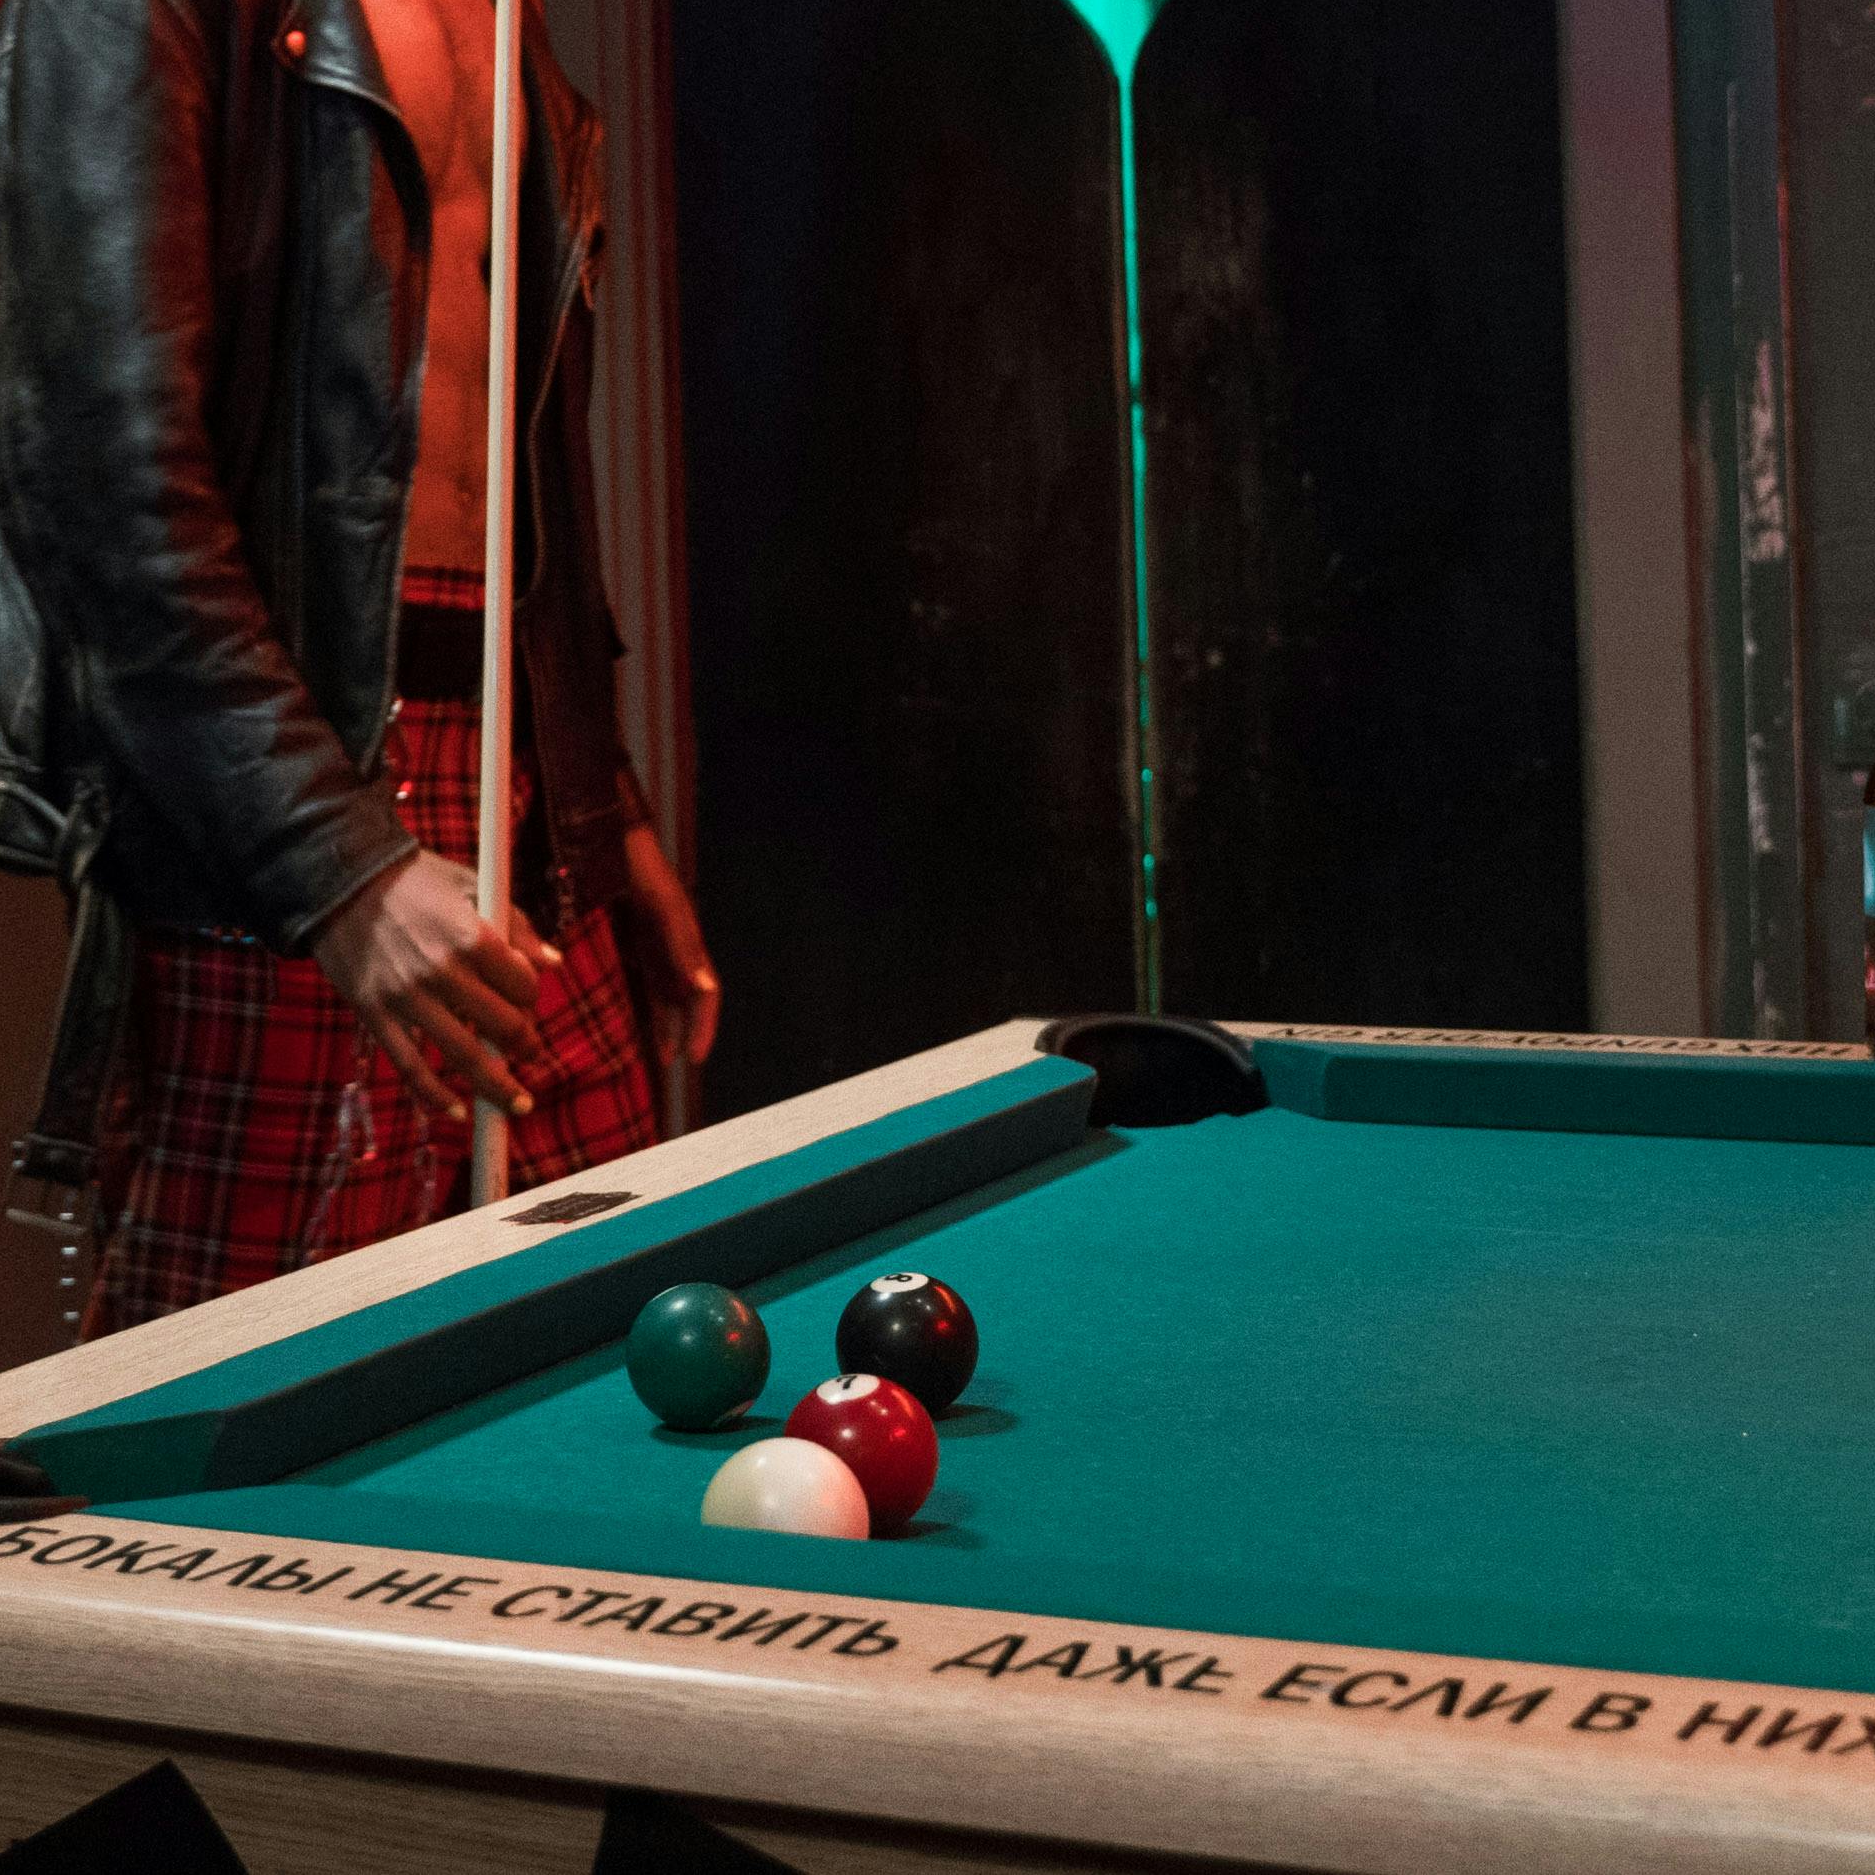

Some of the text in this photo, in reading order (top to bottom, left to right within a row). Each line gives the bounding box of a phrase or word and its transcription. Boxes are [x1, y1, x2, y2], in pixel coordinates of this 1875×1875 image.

[346, 1568, 500, 1611] НЕ
[491, 1584, 900, 1657] СТАВИТЬ
[930, 1633, 1234, 1695] ДАЖЕ
[1258, 1662, 1555, 1725] ЕСЛИ
[1569, 1691, 1652, 1734] В
